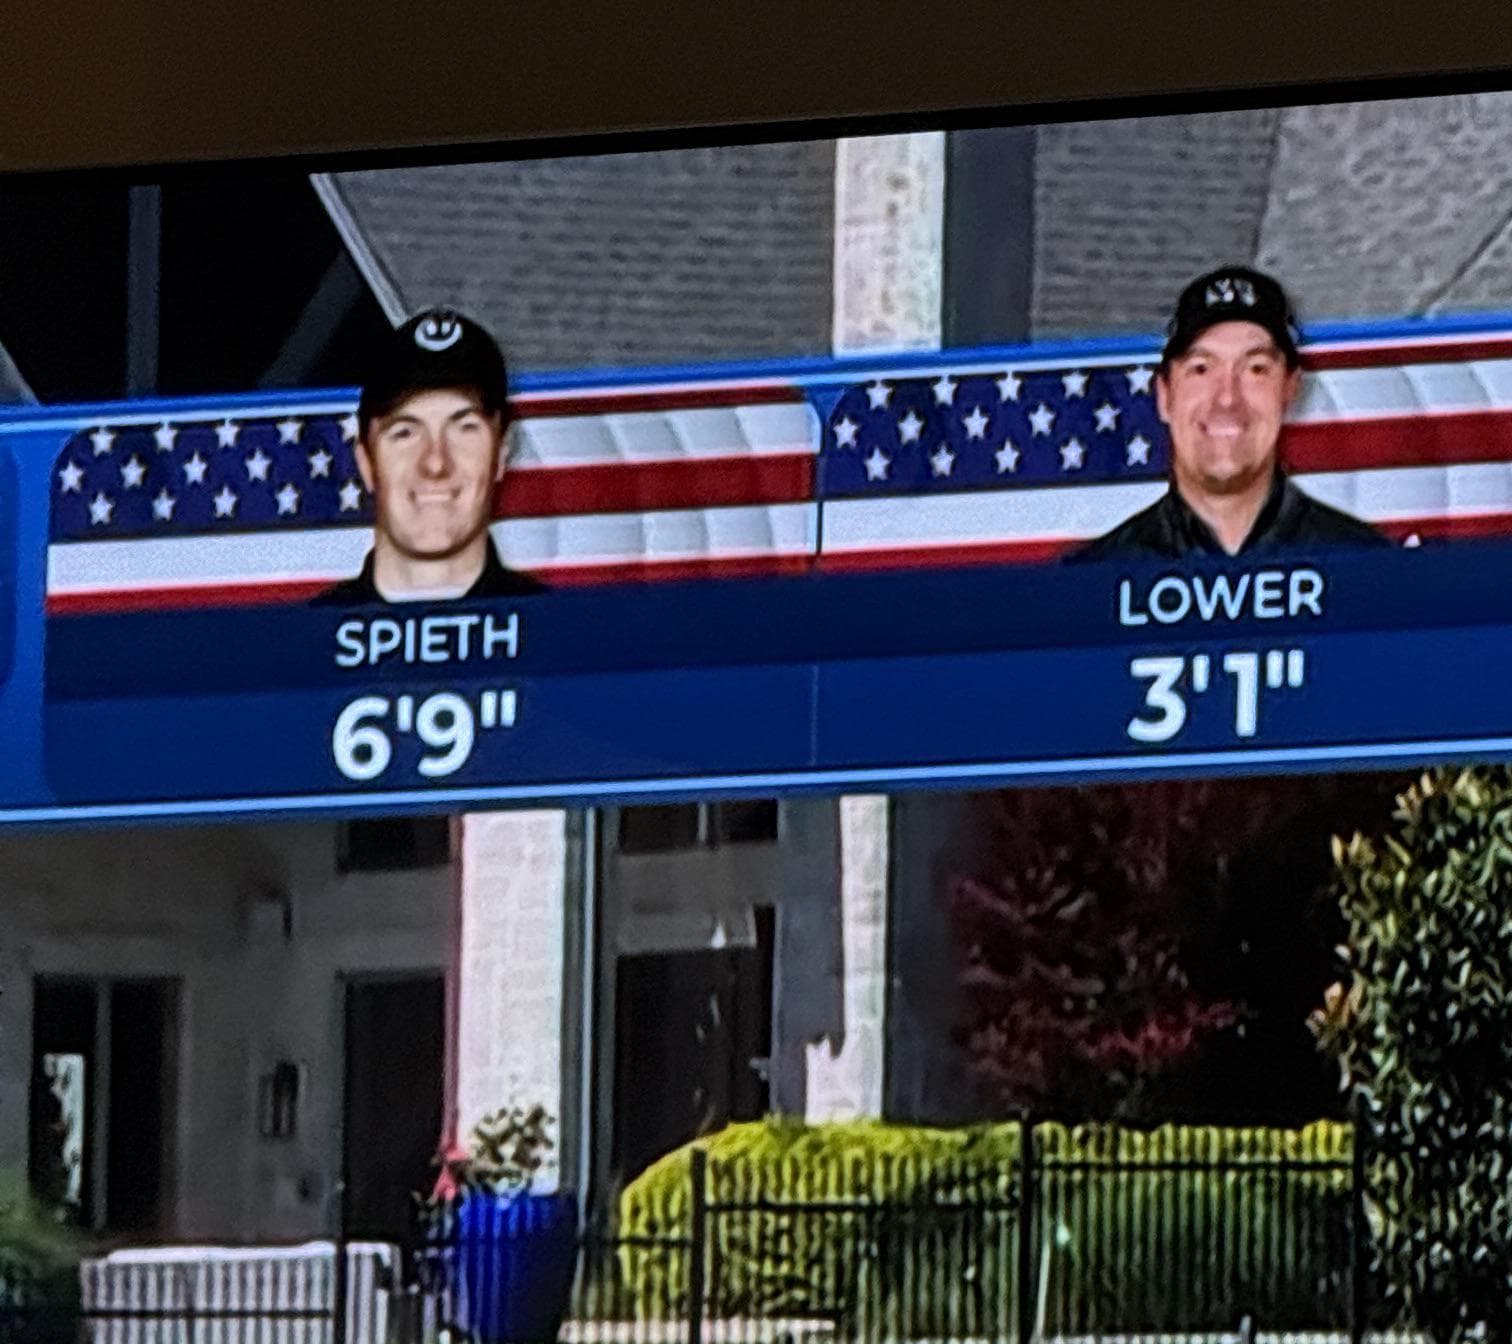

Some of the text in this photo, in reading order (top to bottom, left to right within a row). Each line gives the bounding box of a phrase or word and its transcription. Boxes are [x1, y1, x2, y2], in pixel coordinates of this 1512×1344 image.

[1119, 569, 1323, 625] LOWER
[336, 613, 518, 666] SPIETH
[1127, 648, 1304, 742] 3'1"
[332, 690, 516, 779] 6'9"
